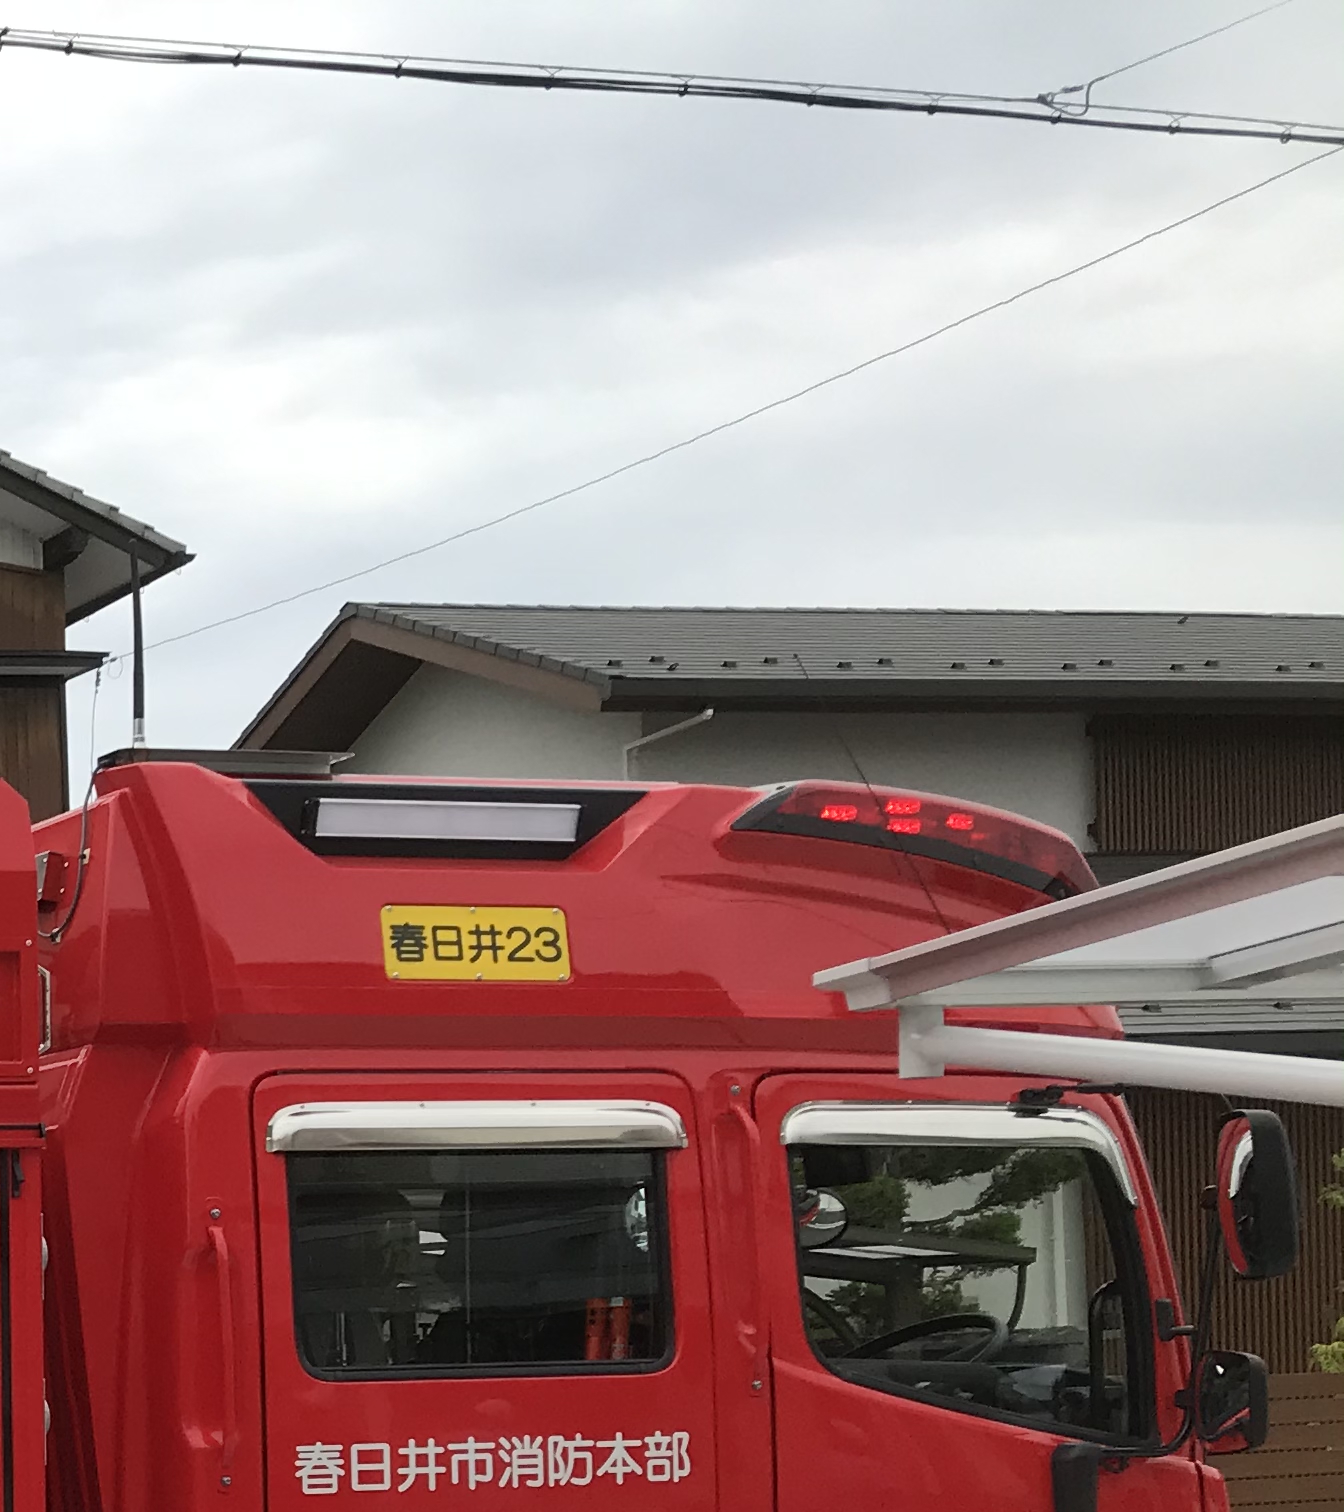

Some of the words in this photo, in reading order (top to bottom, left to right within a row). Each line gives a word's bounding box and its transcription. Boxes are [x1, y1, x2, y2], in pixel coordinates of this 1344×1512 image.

[389, 922, 563, 964] 春日井23
[294, 1430, 692, 1496] 春日井市消防本部
